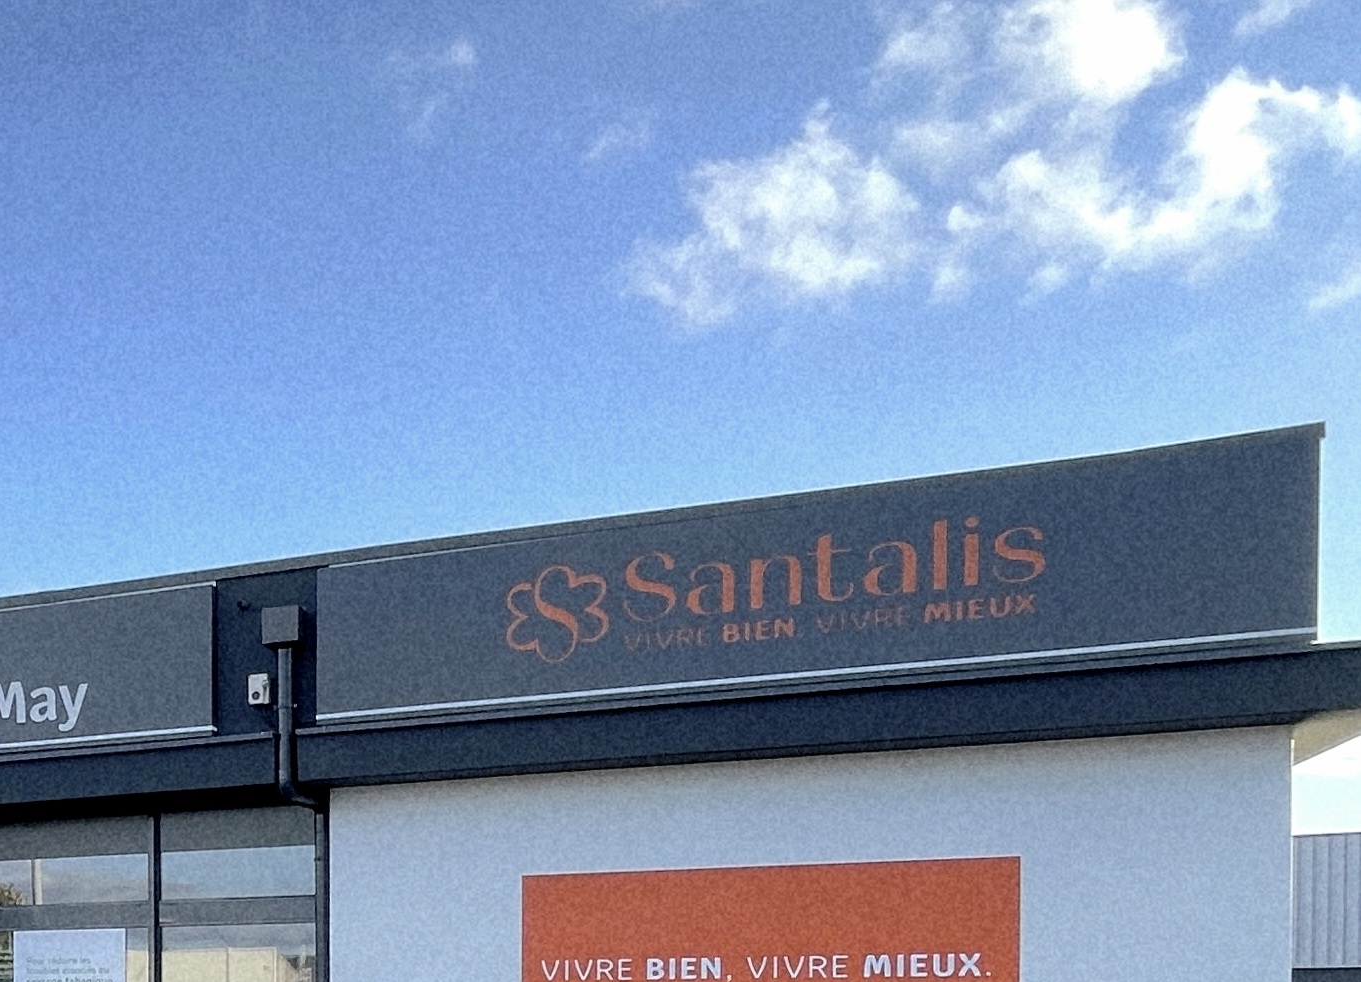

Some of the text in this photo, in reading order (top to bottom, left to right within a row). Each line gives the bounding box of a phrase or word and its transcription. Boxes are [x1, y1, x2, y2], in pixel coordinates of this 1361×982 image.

[624, 516, 1046, 622] Santalis
[623, 626, 708, 652] VIVRE
[816, 605, 909, 634] VIVRE
[924, 594, 1037, 624] MIEUX
[541, 953, 992, 982] VIVRE BIEN, VIVRE MIEUX.
